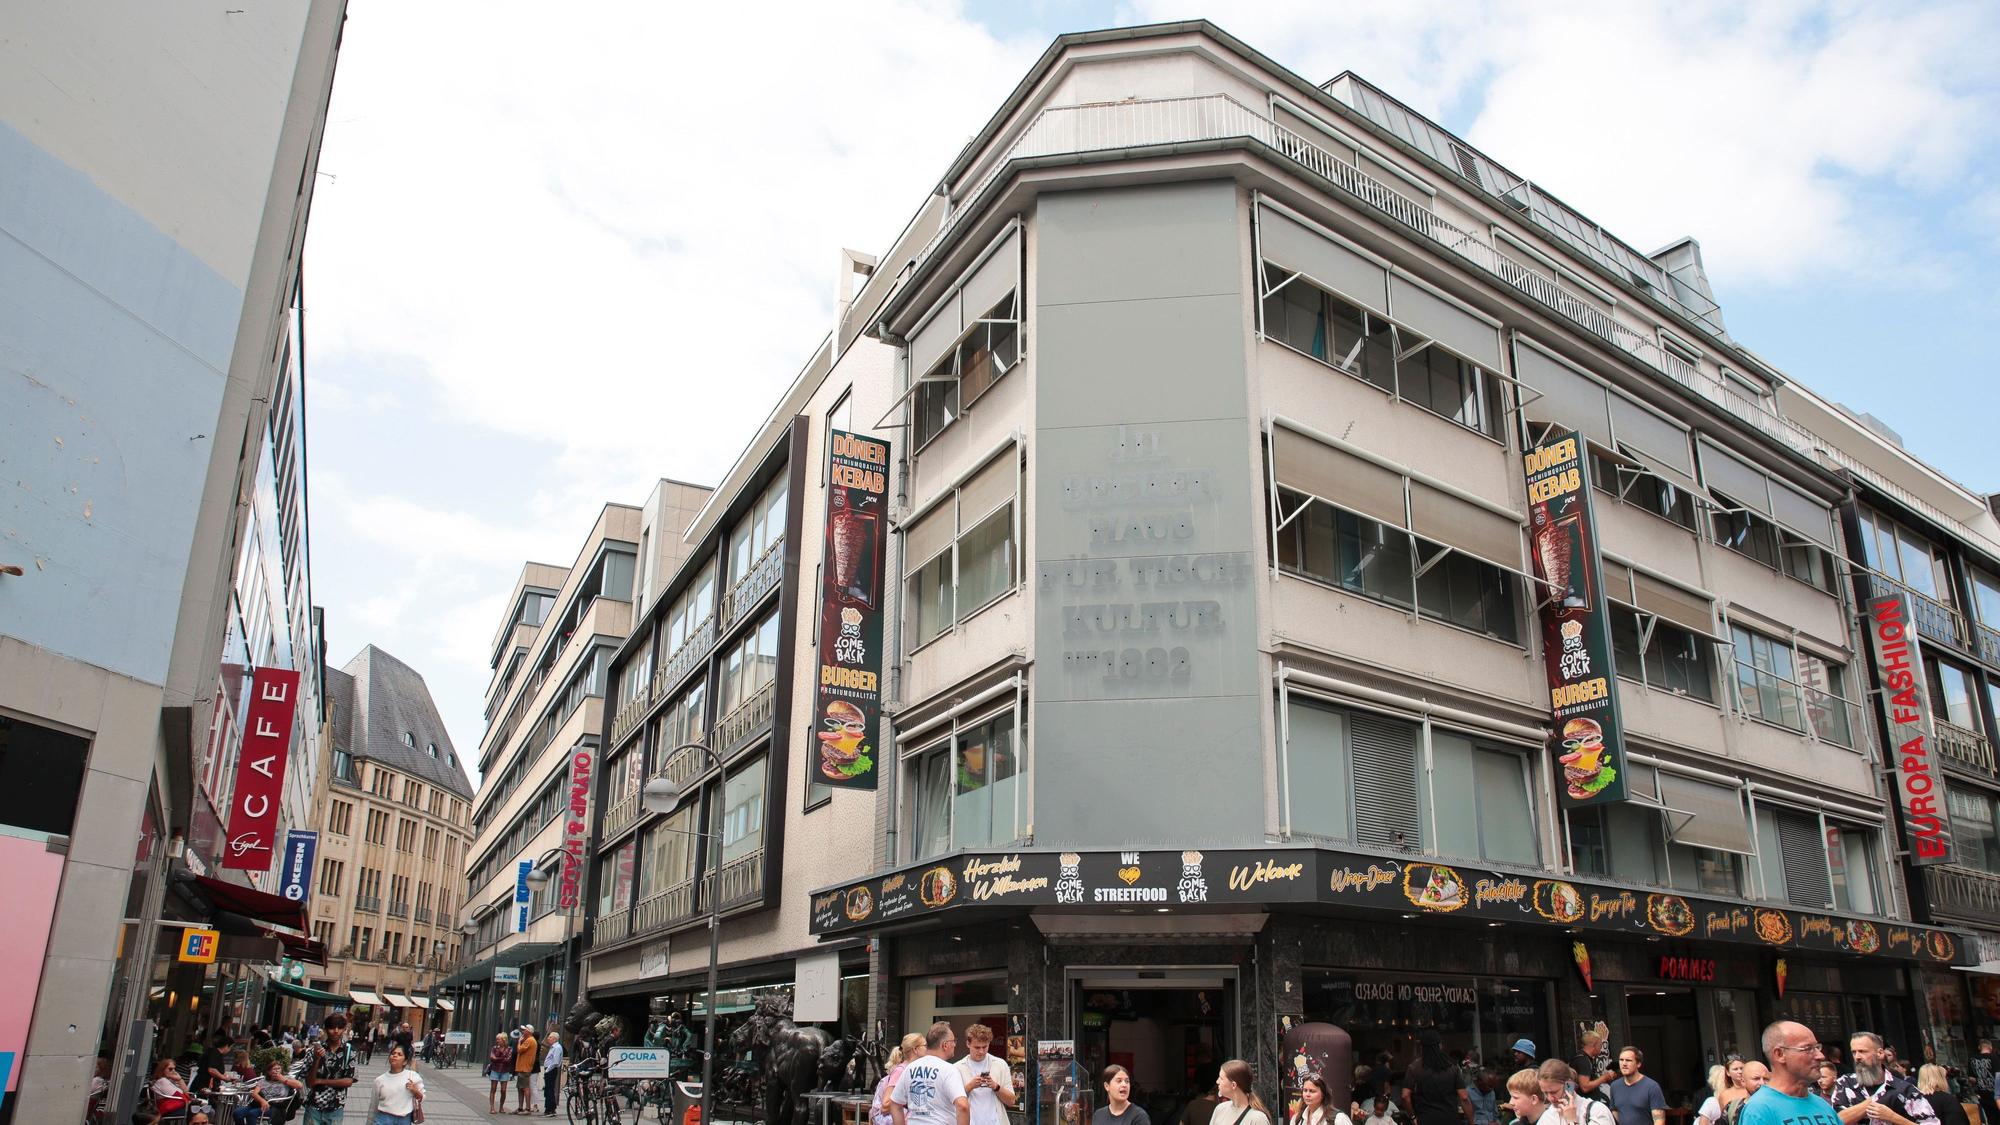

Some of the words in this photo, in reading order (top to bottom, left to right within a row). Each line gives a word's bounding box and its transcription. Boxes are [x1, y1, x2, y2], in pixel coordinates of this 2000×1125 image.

[834, 434, 885, 465] DÖNER
[1525, 438, 1577, 476] DÖNER
[832, 464, 885, 494] KEBAB
[1528, 468, 1580, 506] KEBAB
[835, 636, 864, 651] COME
[836, 649, 865, 664] BACK
[1561, 649, 1588, 667] COME
[1874, 599, 1920, 726] FASHION
[821, 664, 877, 691] BURGER
[1562, 660, 1591, 680] BACK
[820, 686, 877, 700] PREMIUMQUALITÄT
[1552, 677, 1608, 709] BURGER
[1553, 700, 1609, 718] PREMIUMQUALITÄT
[244, 681, 288, 818] CAFE
[569, 752, 592, 818] OLYMP
[1900, 736, 1946, 859] EUROPA
[567, 821, 585, 836] &
[292, 842, 306, 883] KERN
[963, 854, 1021, 883] Herzlich
[1121, 852, 1140, 865] WE
[560, 840, 584, 910] HADES
[1057, 879, 1082, 891] COME
[1179, 878, 1205, 890] COME
[1229, 859, 1303, 891] Welcome
[973, 876, 1048, 900] Willkommen
[1056, 889, 1083, 903] BACK
[1094, 888, 1167, 902] STREETFOOD
[1179, 889, 1208, 903] BACK
[1660, 956, 1716, 982] POMMES
[620, 1052, 657, 1061] OCURA
[909, 1066, 939, 1080] VANS
